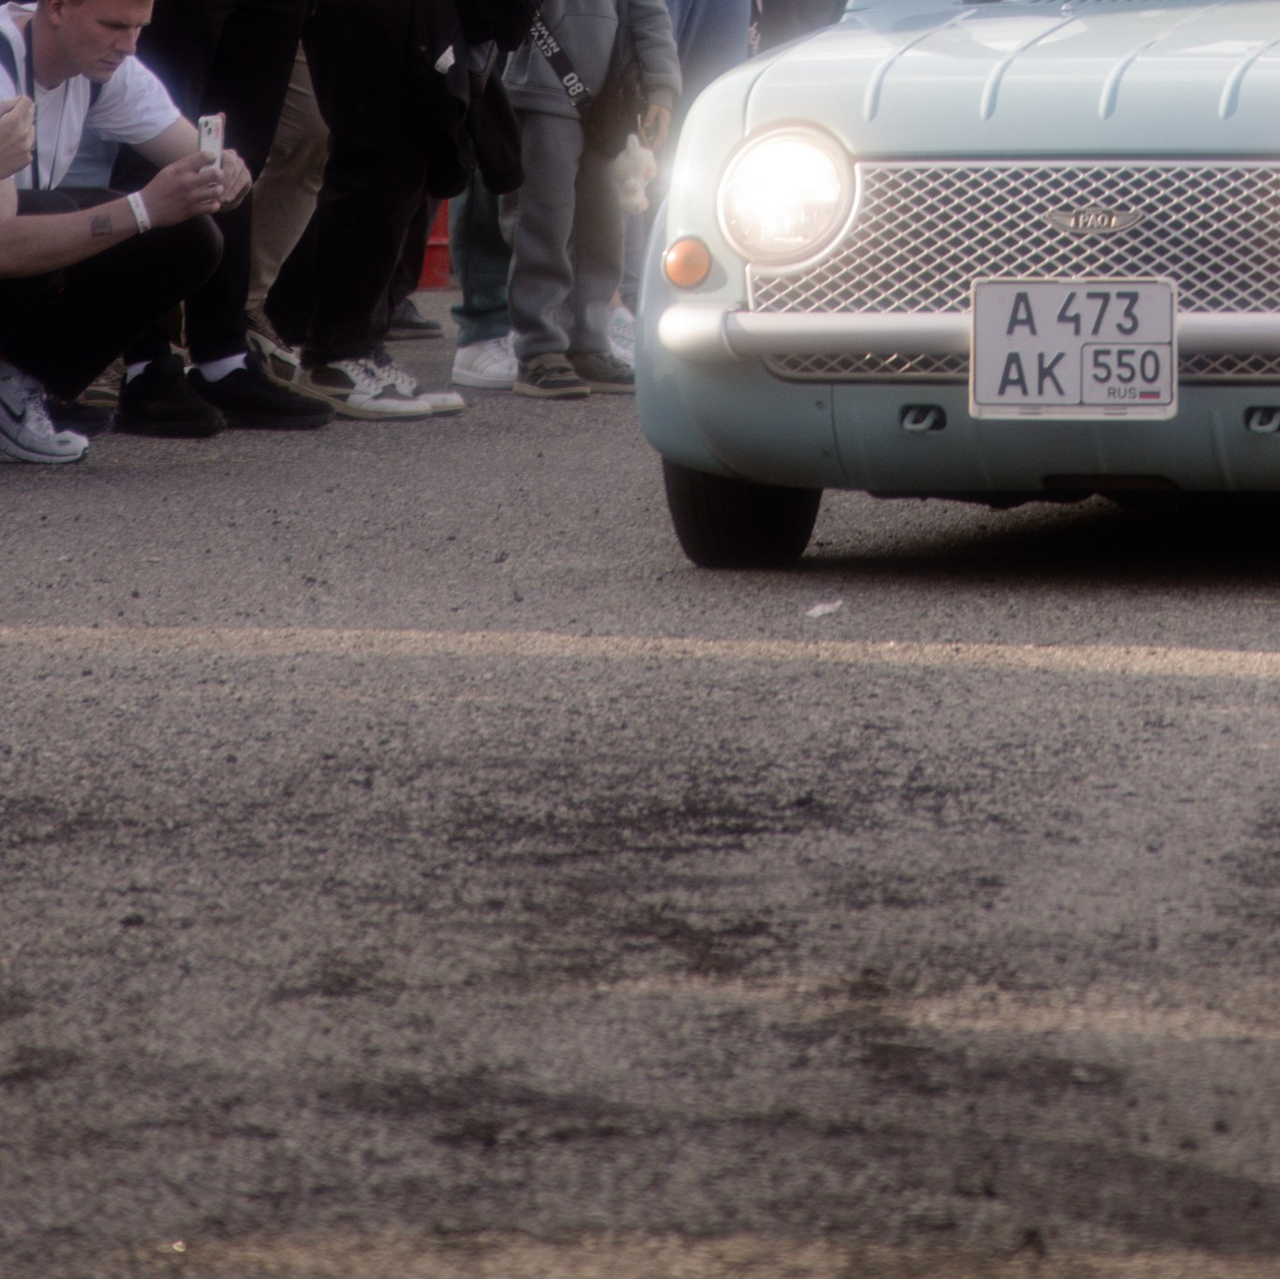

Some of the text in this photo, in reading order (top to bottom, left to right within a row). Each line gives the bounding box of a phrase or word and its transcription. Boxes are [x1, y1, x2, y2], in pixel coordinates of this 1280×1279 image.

[1078, 213, 1109, 229] PAO
[1005, 291, 1140, 336] A 473
[997, 351, 1066, 396] AK
[1092, 348, 1161, 384] 550
[1107, 387, 1138, 399] RUS
